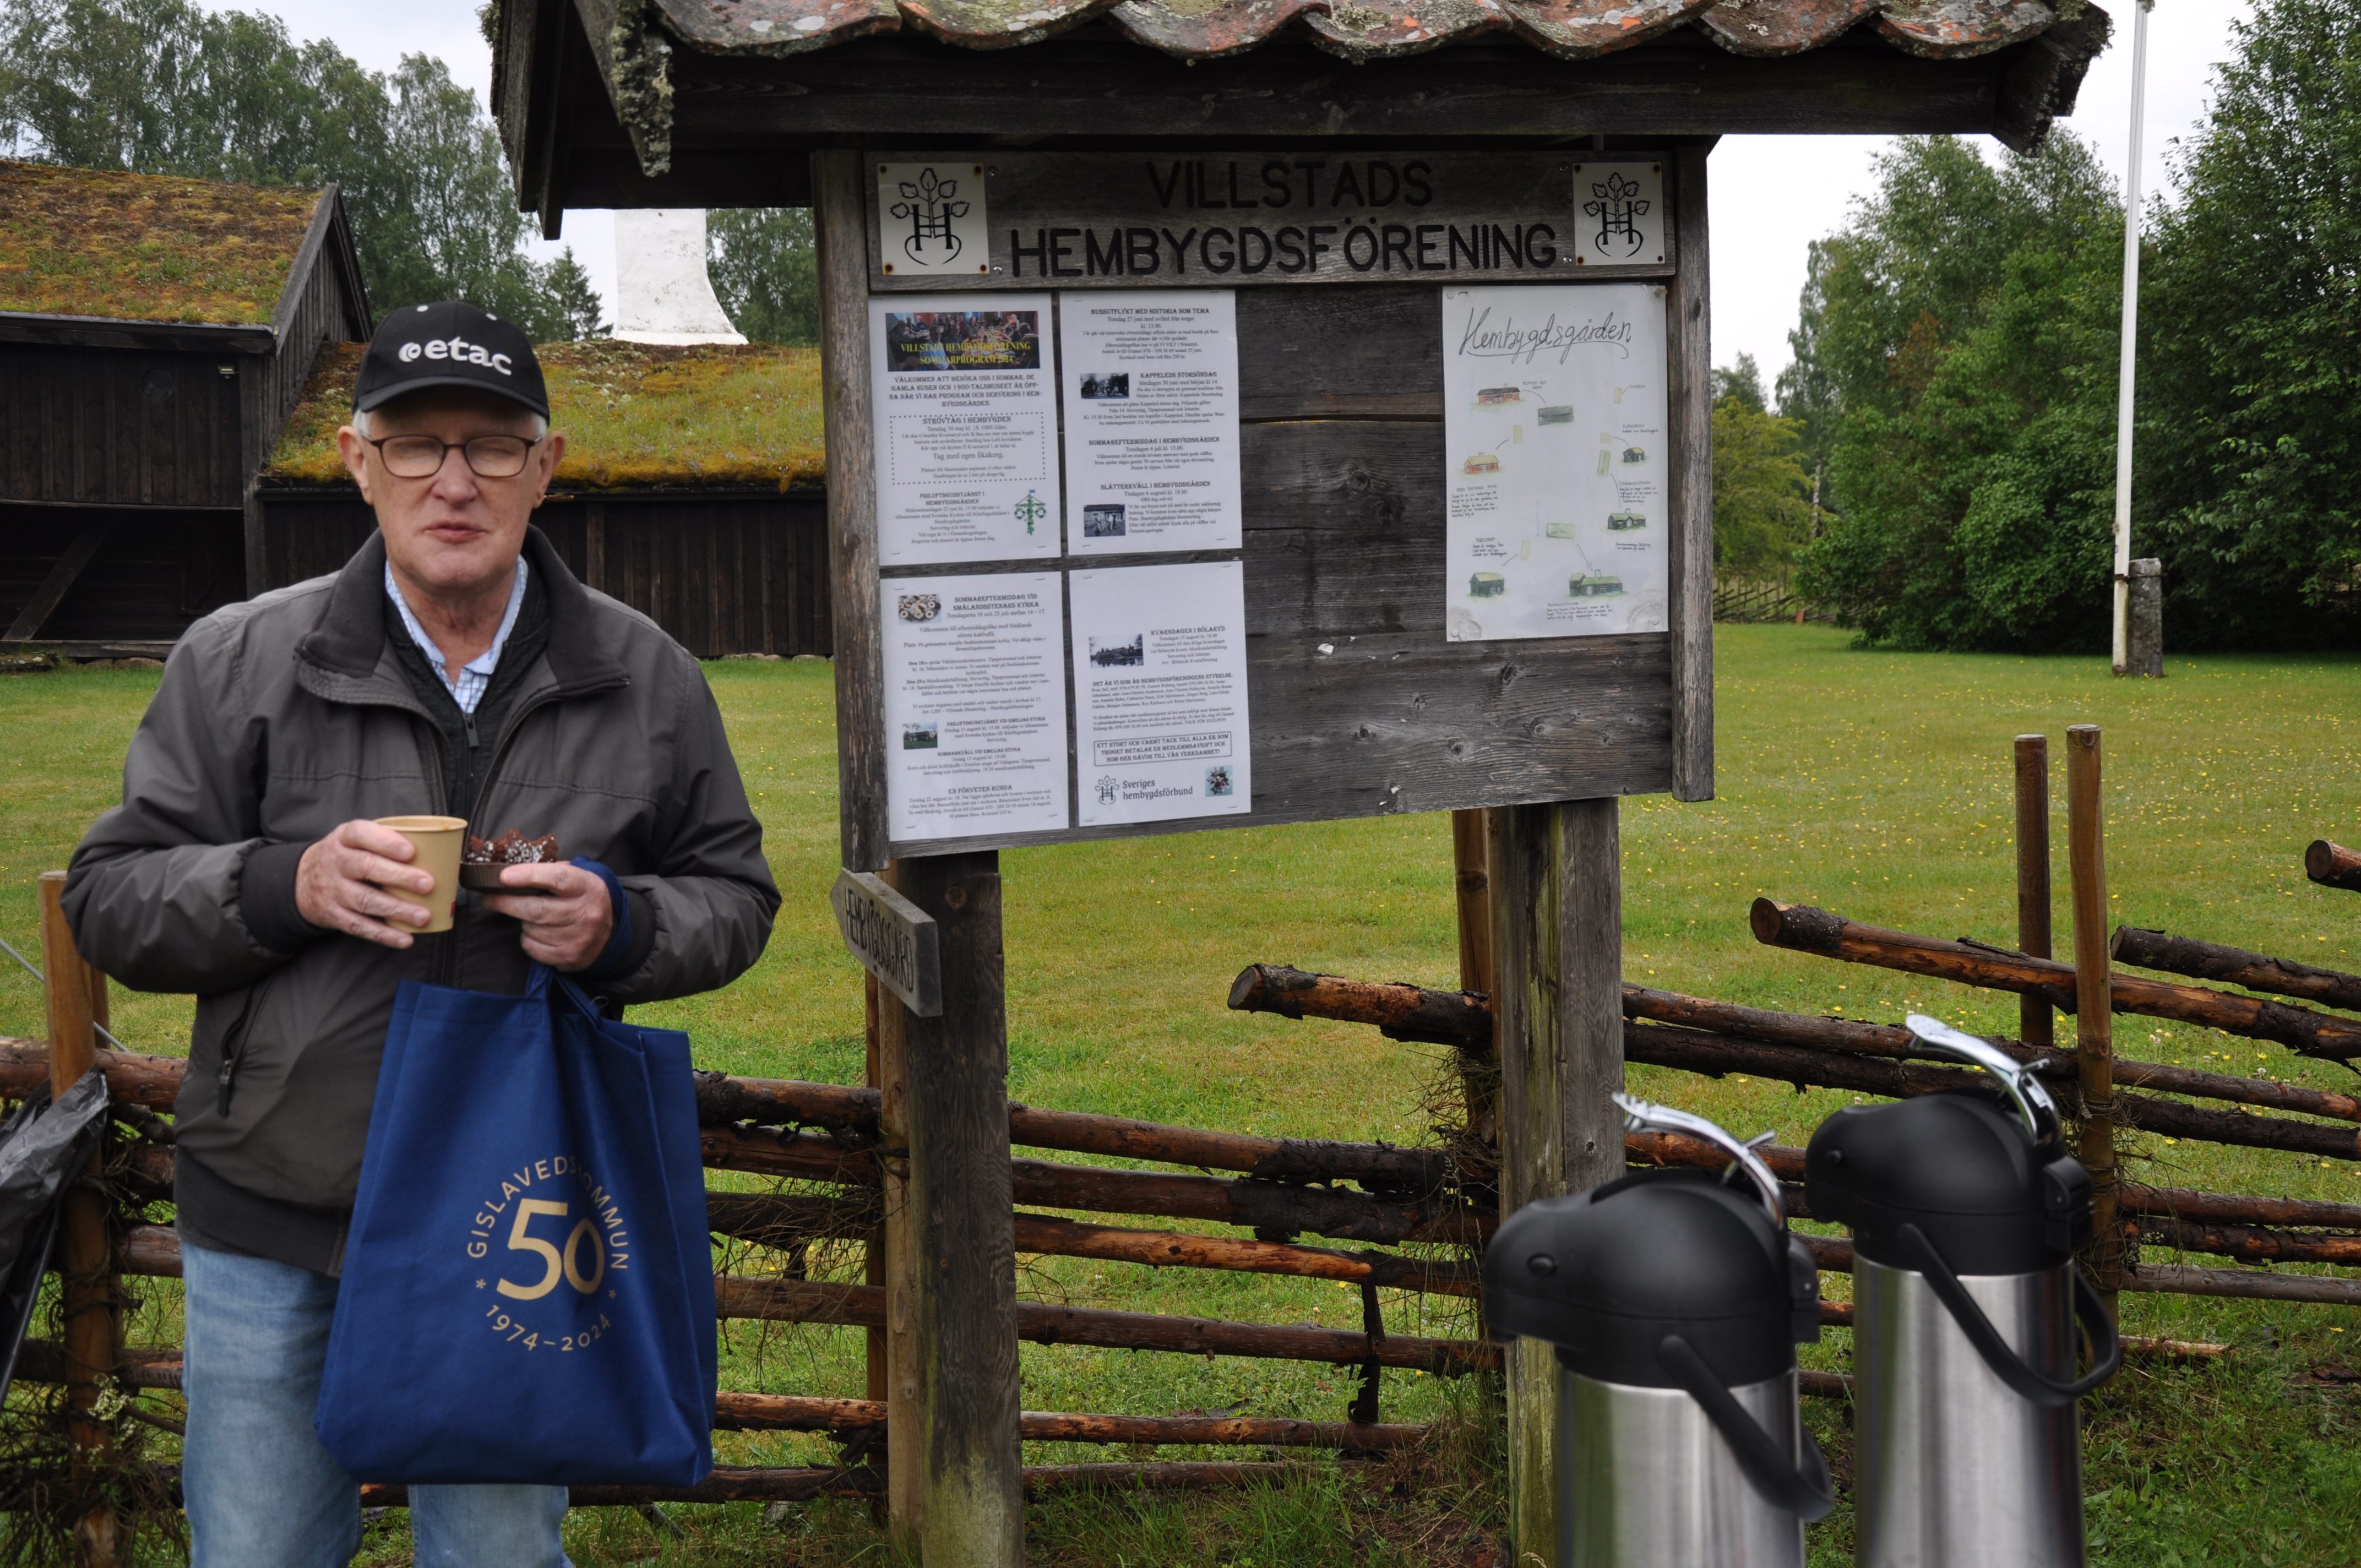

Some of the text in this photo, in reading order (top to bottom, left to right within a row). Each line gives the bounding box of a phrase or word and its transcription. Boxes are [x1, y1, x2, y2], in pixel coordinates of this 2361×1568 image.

[1146, 160, 1432, 208] VILLSTADS
[1010, 216, 1557, 277] HEMBYGDSFÖRENING
[946, 341, 1031, 351] HEMBYGDSFÖRENING
[1458, 306, 1631, 364] Hembygdsgården
[424, 336, 512, 375] etac
[920, 354, 996, 364] SOMMARPROGRAM
[954, 594, 1025, 602] SOMMAREFTERMIDDAG
[1141, 674, 1204, 683] HEMBYGDSFÖRENINGENS
[1162, 742, 1212, 750] MEDLEMMSAVGIFT
[1122, 779, 1156, 790] Sveriges
[1123, 786, 1193, 801] hembygdsförbund
[844, 885, 914, 993] HEMBYGDSGÅRD
[467, 1156, 576, 1259] GISLAVEDS
[496, 1197, 605, 1301] 50
